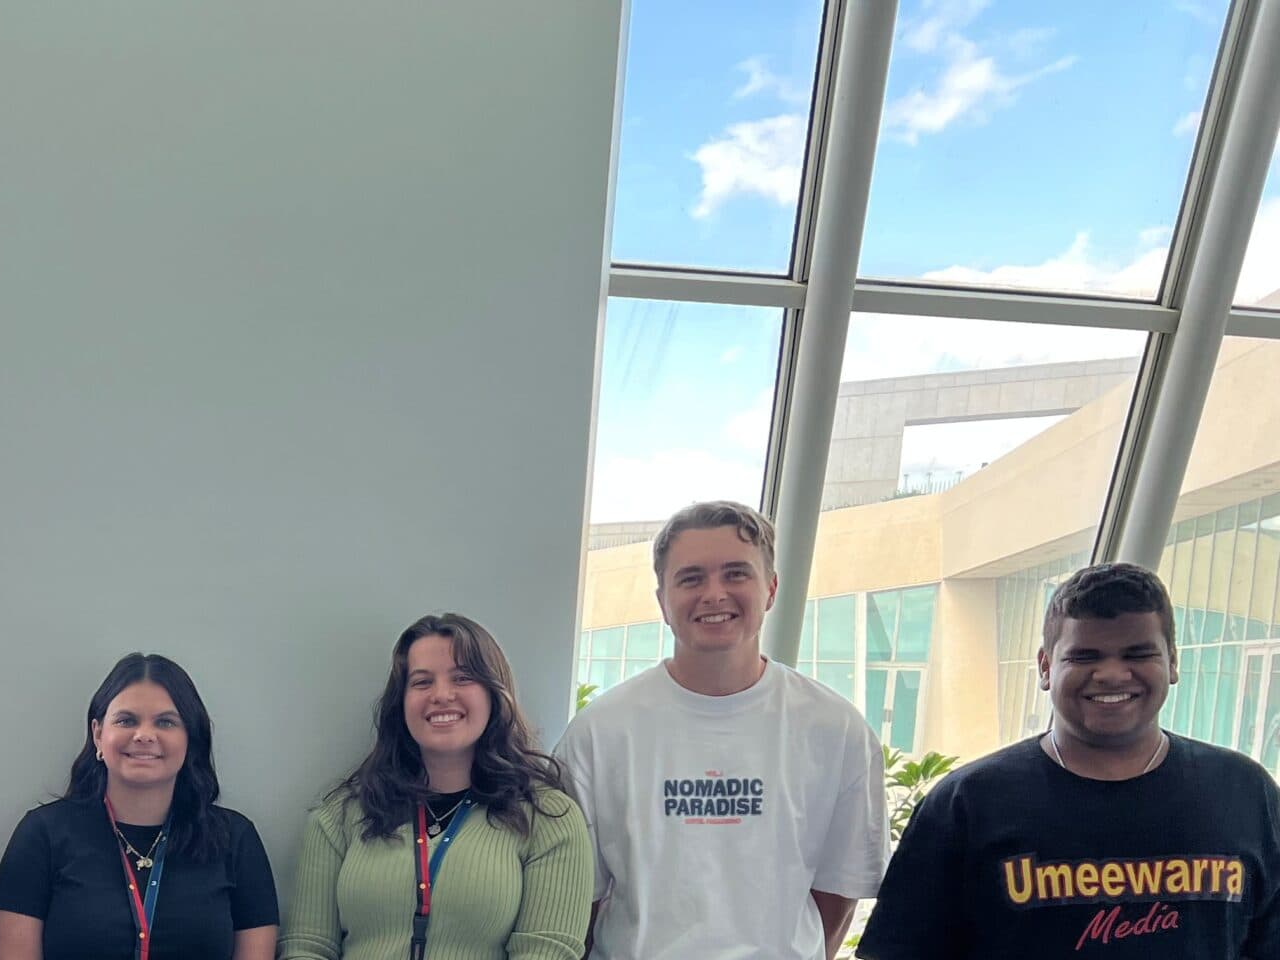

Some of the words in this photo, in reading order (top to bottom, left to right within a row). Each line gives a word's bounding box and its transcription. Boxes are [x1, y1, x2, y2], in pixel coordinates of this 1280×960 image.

[664, 778, 763, 797] NOMADIC
[664, 798, 763, 816] PARADISE
[1004, 857, 1243, 904] Umeewarra
[1075, 901, 1179, 950] Media
